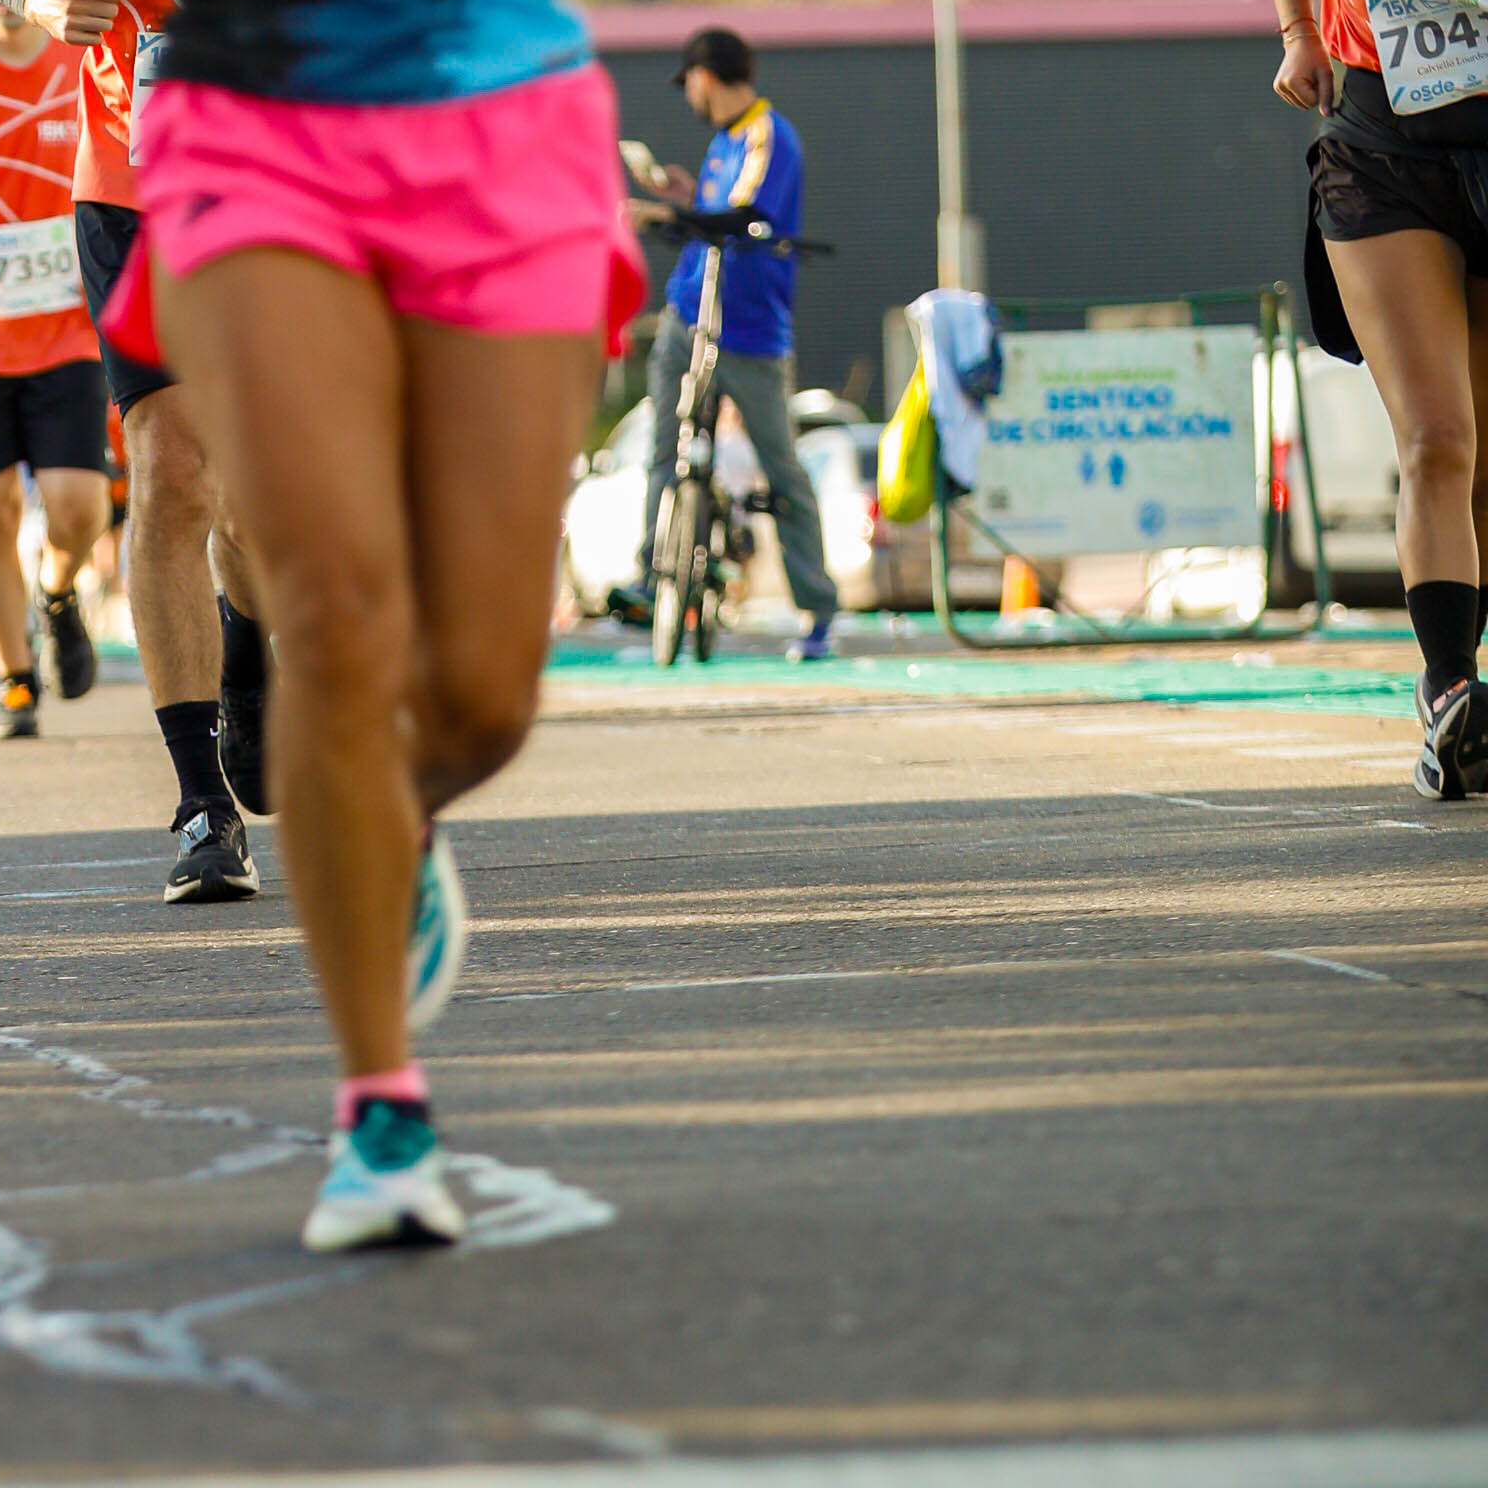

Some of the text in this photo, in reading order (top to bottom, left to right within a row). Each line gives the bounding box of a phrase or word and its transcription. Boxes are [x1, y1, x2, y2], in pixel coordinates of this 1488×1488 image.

[1380, 11, 1488, 69] 704
[1410, 79, 1455, 102] osde
[1046, 385, 1173, 411] SENTIDO
